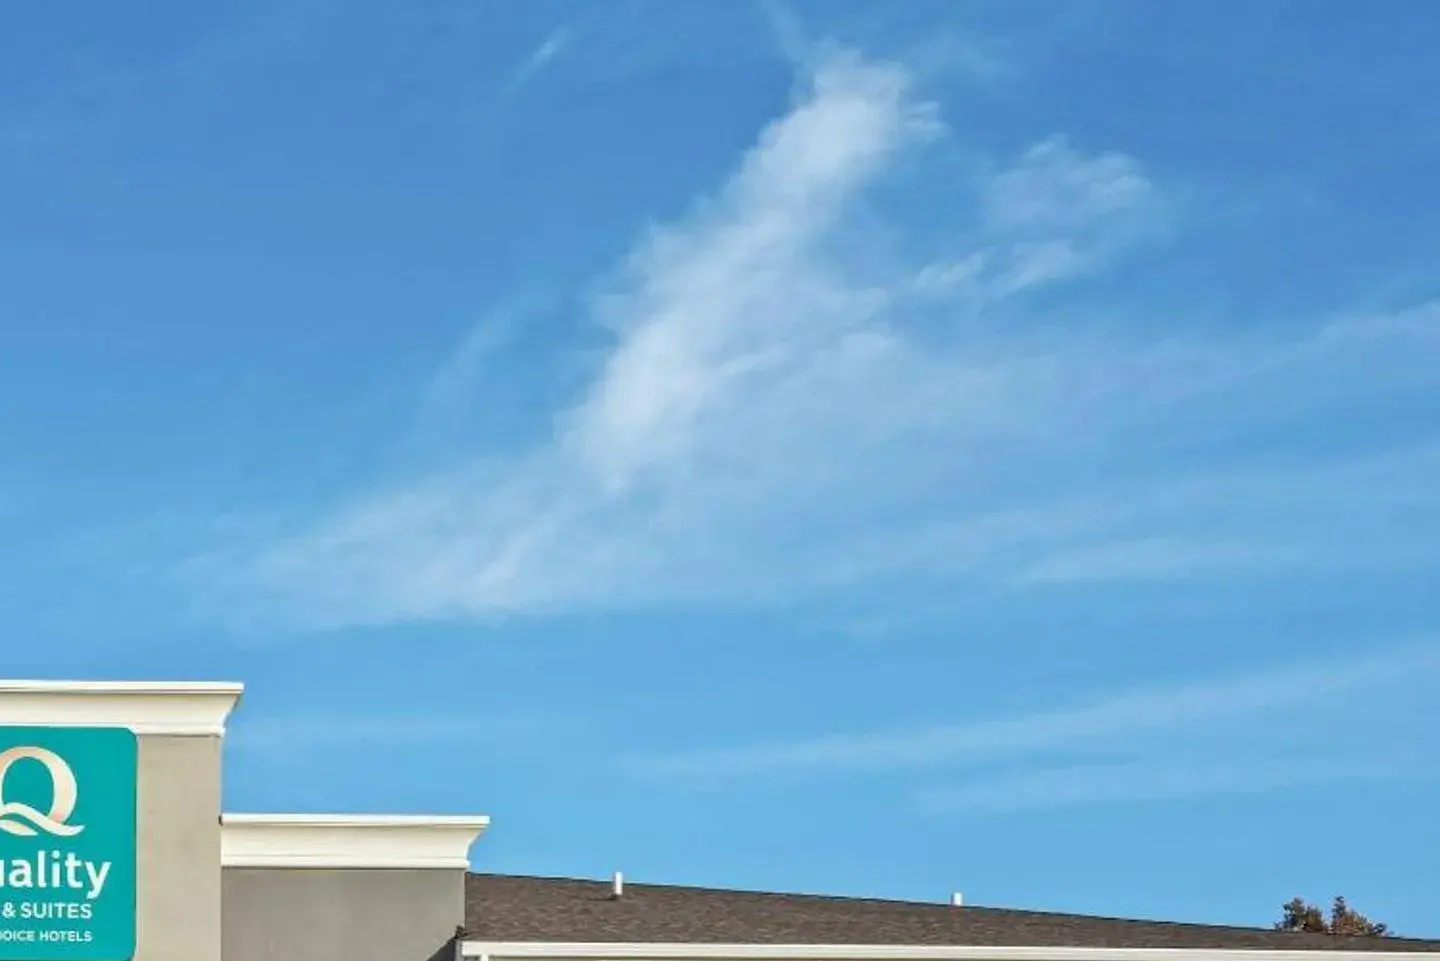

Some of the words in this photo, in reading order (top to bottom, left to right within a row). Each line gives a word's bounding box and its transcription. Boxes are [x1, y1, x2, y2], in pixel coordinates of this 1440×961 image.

[2, 901, 17, 919] &
[20, 901, 93, 919] SUITES
[39, 930, 93, 942] HOTELS
